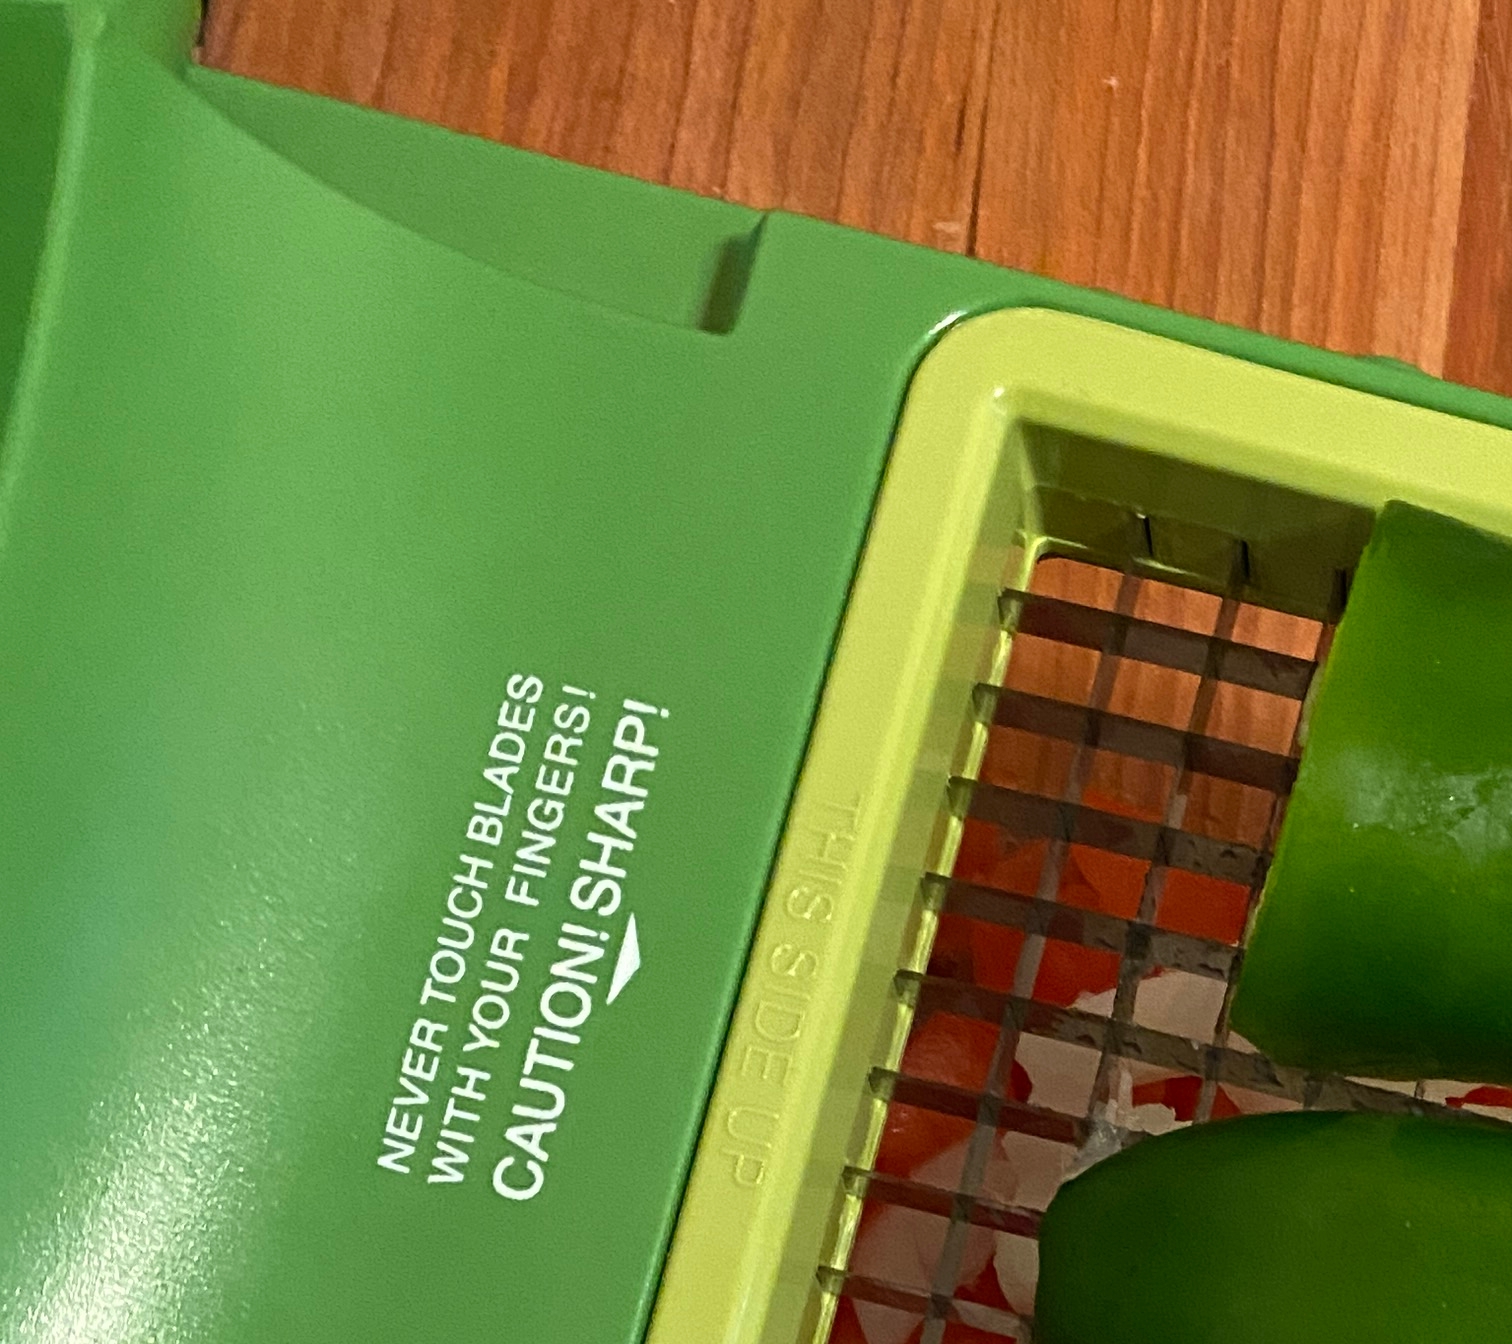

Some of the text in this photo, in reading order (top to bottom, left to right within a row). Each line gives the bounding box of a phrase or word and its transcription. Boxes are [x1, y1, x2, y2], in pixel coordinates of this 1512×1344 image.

[378, 674, 544, 1174] NEVER TOUCH BLADES
[427, 1065, 491, 1184] WITH
[463, 927, 530, 1053] YOUR
[492, 698, 671, 1200] CAUTION! SHARP!
[721, 799, 862, 1186] THIS SIDE UP
